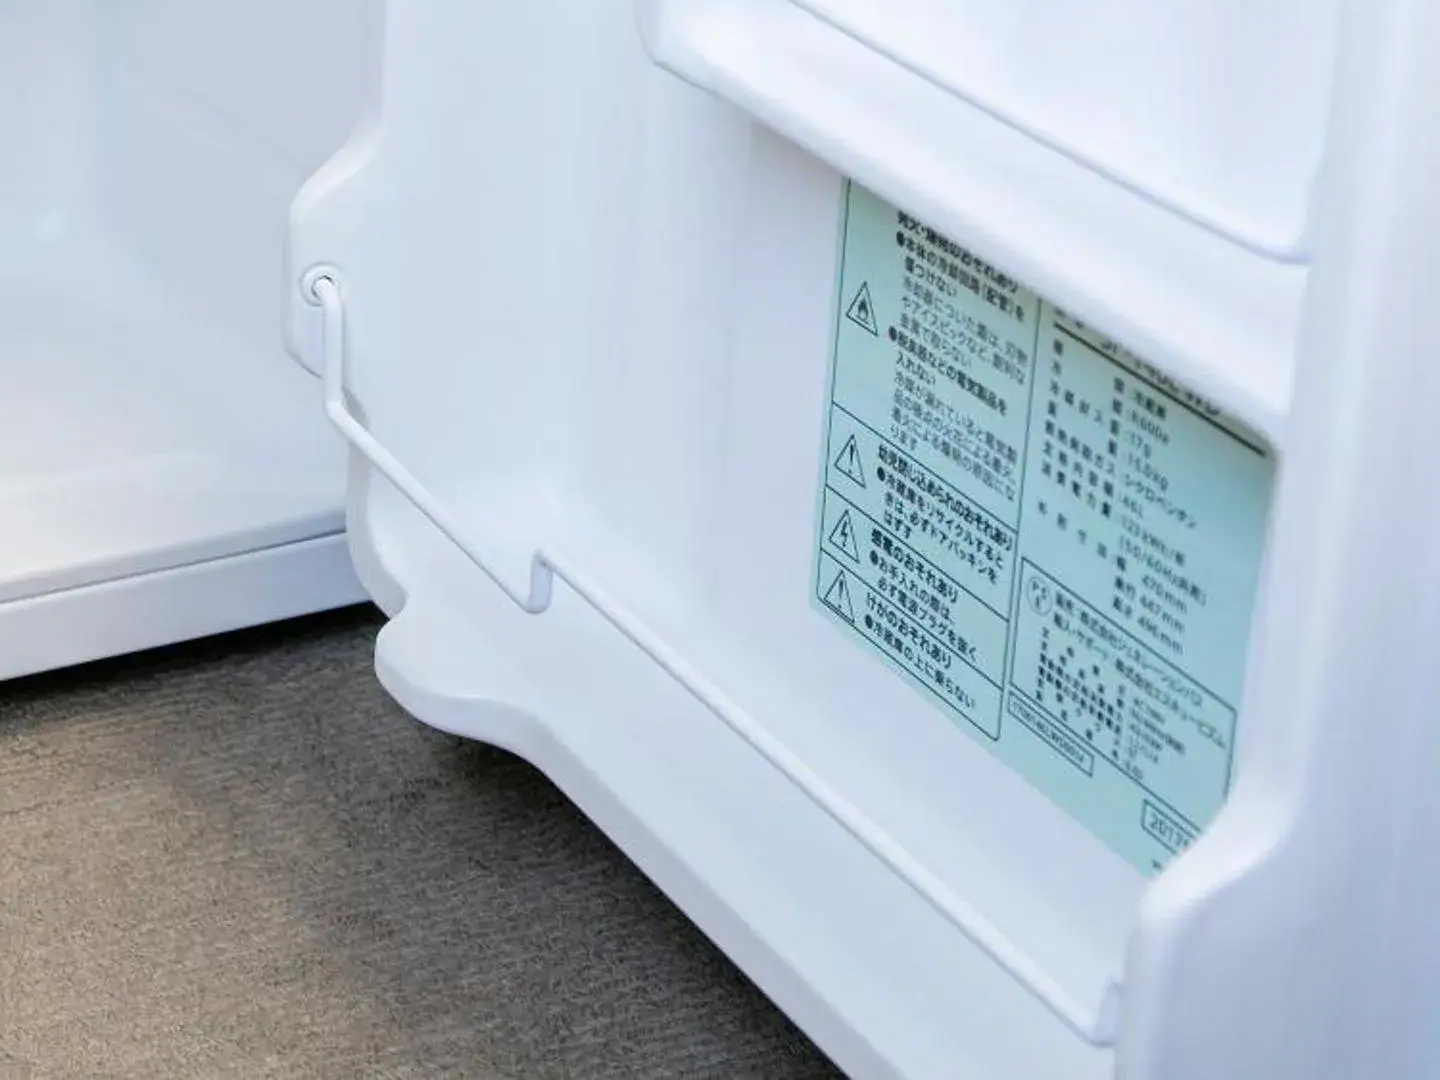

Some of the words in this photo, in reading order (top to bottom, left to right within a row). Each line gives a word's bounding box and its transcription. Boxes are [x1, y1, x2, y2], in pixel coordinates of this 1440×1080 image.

[896, 349, 936, 389] 入れない
[883, 507, 911, 541] はずす
[870, 525, 959, 606] 感電のおそれあり
[865, 589, 951, 672] けがのおそれあり
